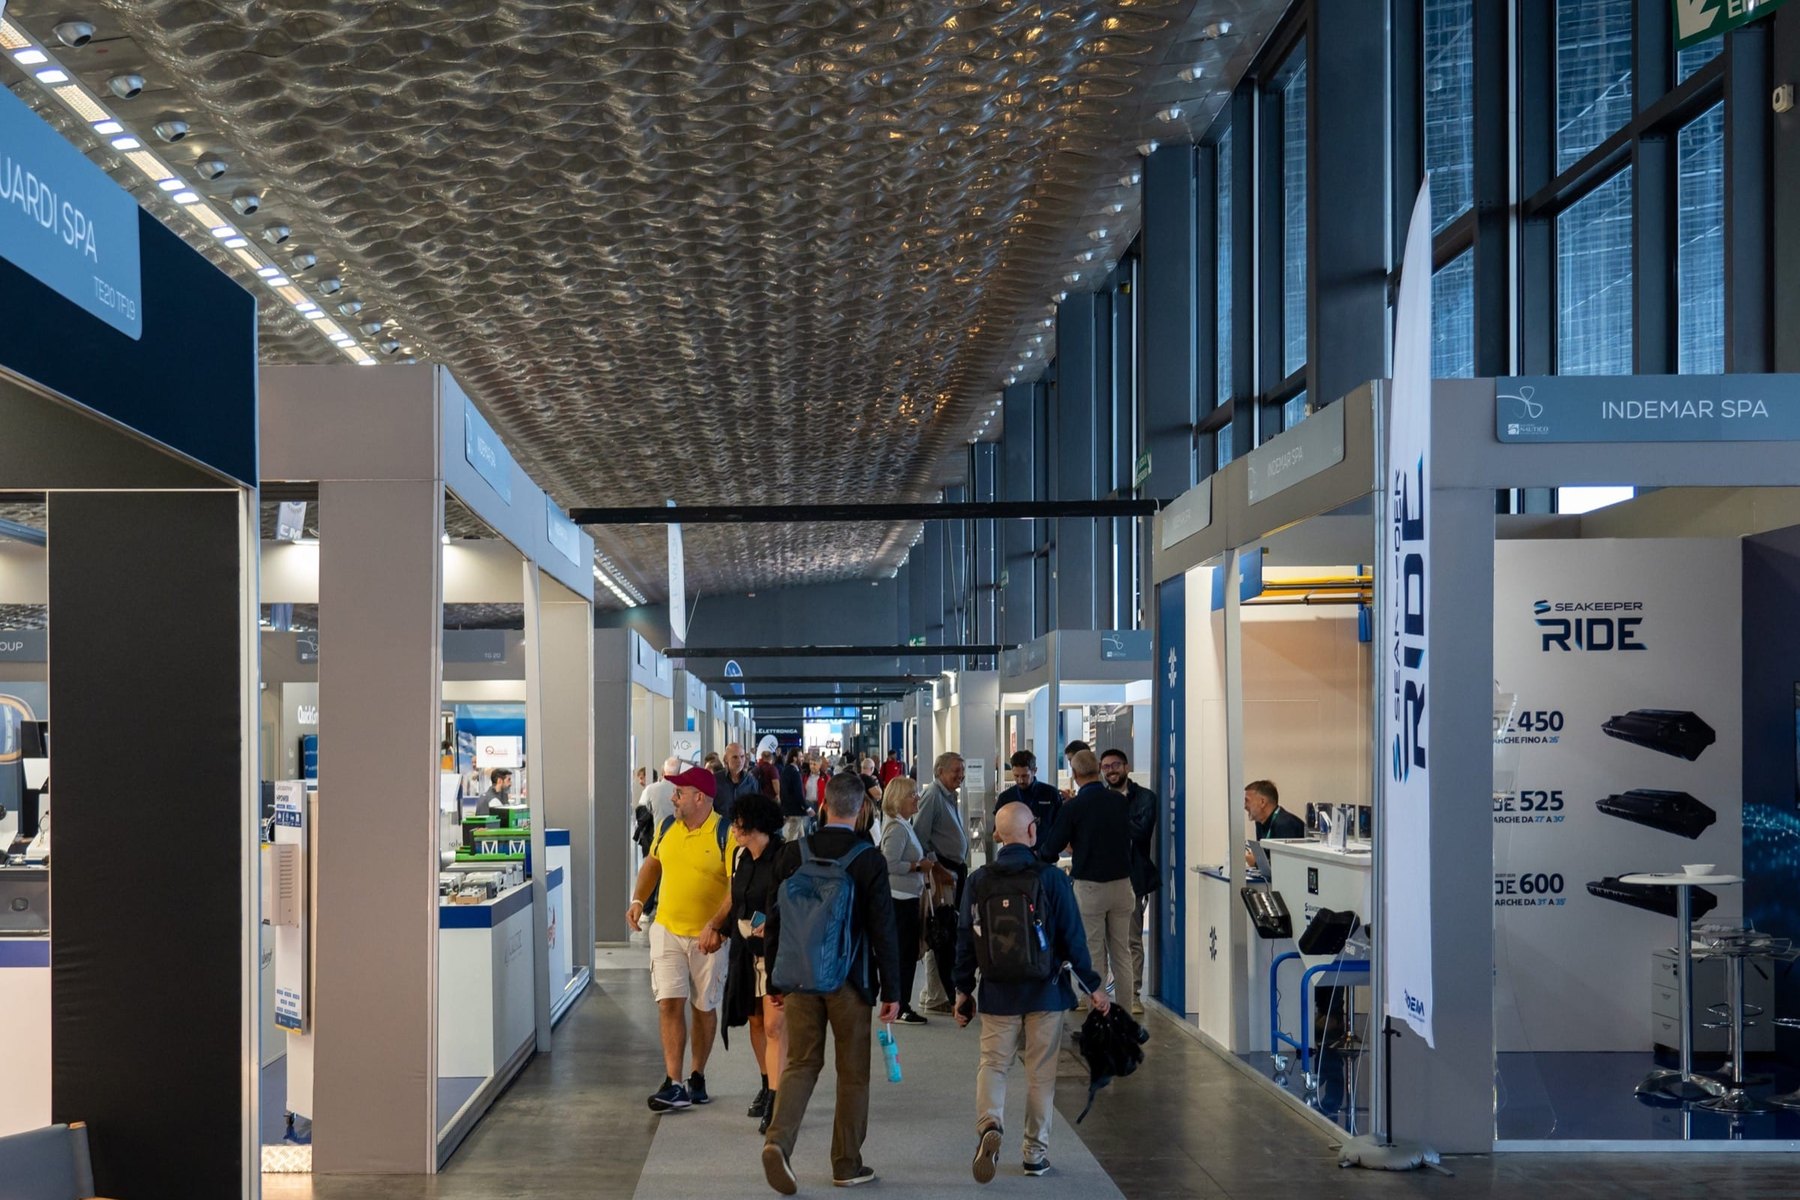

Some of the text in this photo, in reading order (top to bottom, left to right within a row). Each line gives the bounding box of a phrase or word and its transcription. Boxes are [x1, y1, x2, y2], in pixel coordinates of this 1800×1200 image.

[63, 201, 98, 264] SPA
[93, 275, 115, 308] TE20
[1602, 399, 1769, 419] INDEMAR SPA
[1555, 602, 1643, 611] SEAKEEPER
[1534, 617, 1648, 651] RIDE
[1517, 710, 1564, 732] 450
[1520, 736, 1541, 744] FINO
[1541, 736, 1548, 744] A
[1520, 790, 1564, 811] 525
[1520, 873, 1564, 894] 600
